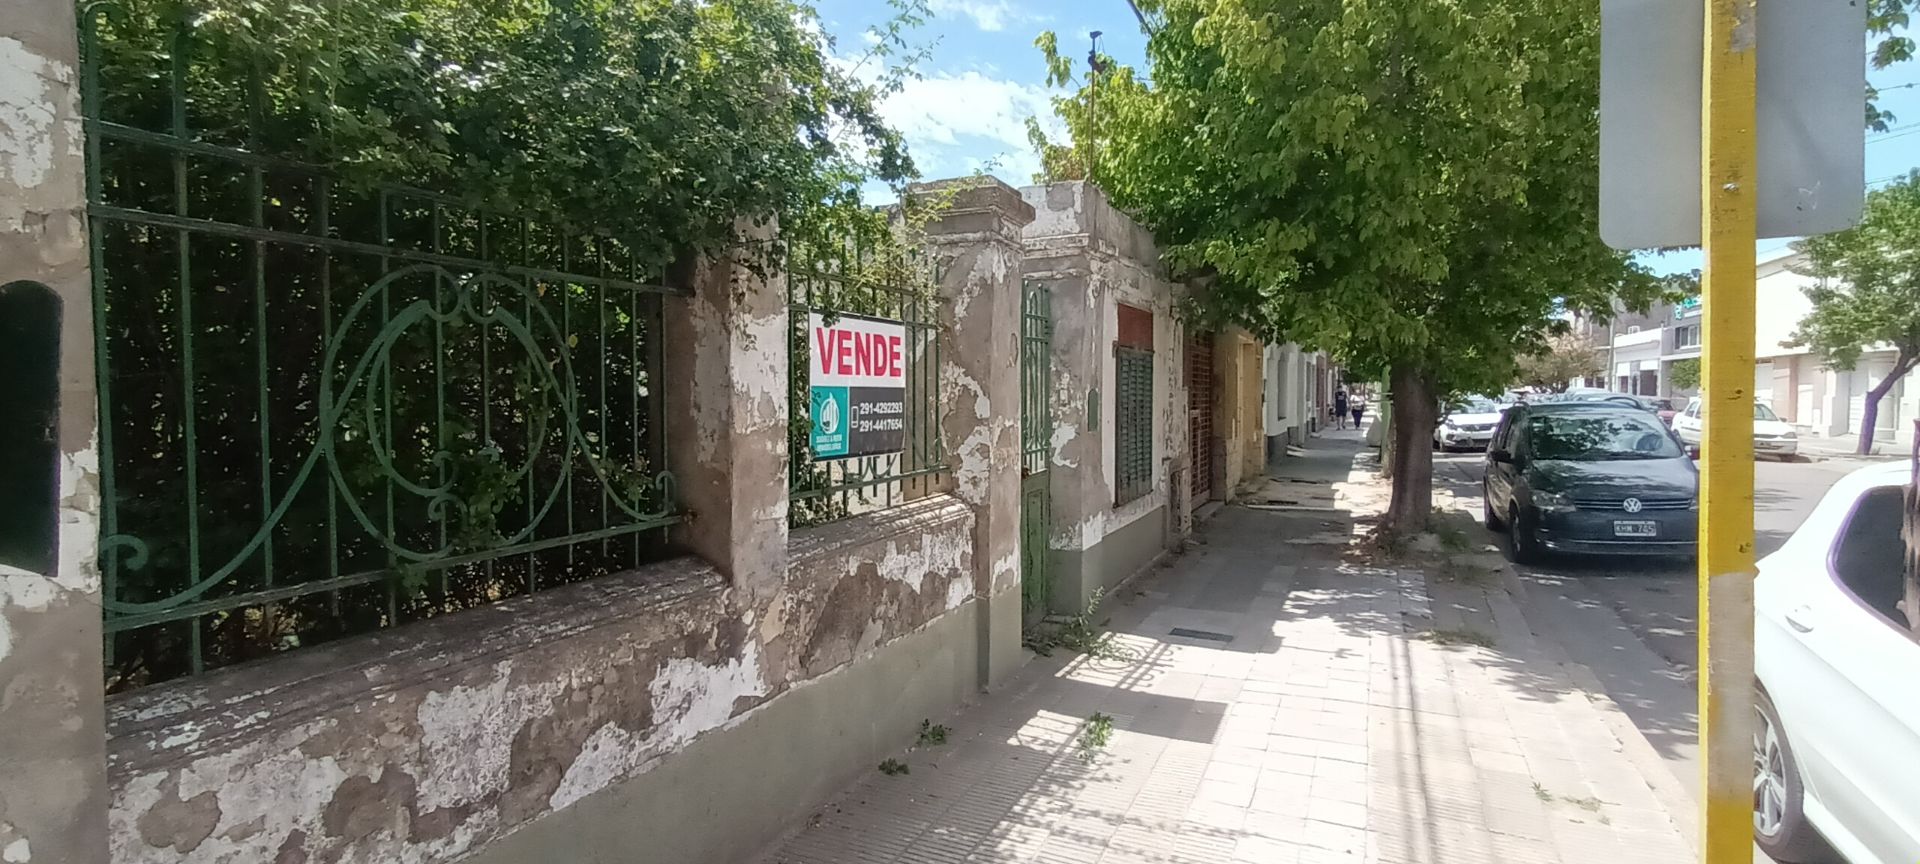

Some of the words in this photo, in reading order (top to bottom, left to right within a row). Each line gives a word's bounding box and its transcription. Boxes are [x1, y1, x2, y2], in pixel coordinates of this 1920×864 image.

[816, 328, 901, 377] VENDE
[860, 402, 903, 415] 291-4292293
[860, 418, 903, 432] 291-4417654
